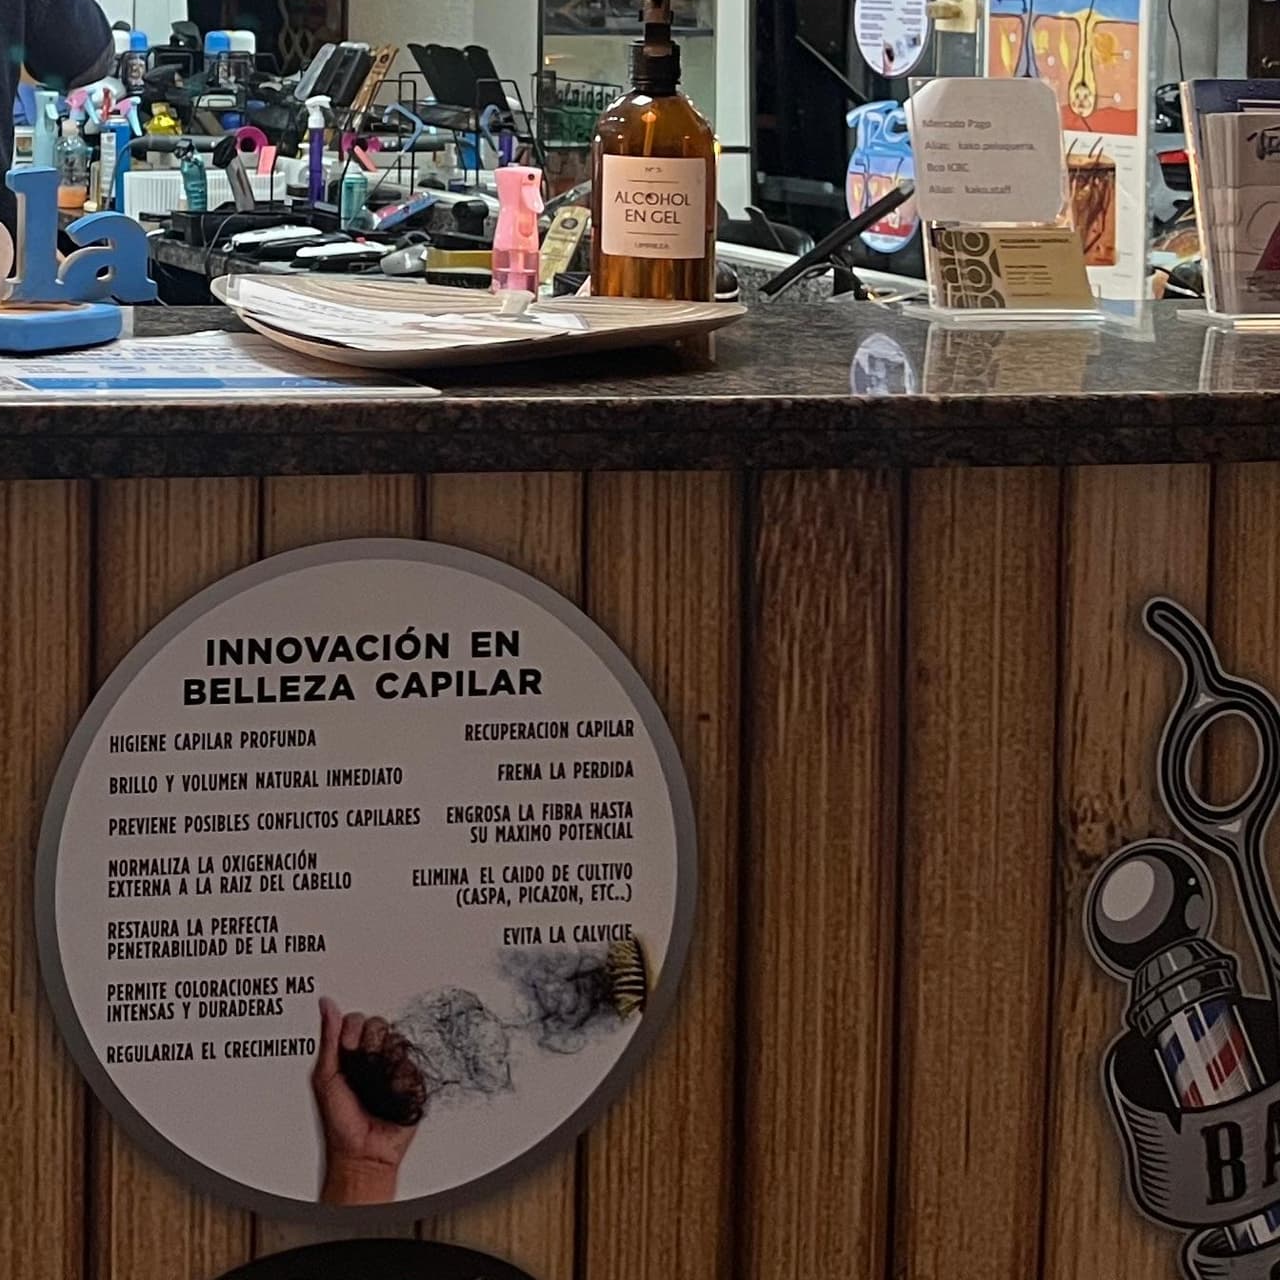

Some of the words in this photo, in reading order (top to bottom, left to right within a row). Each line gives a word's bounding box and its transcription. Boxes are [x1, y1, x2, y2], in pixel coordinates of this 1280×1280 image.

[614, 190, 691, 207] ALCOHOL
[625, 209, 646, 223] EN
[650, 210, 682, 225] GEL
[207, 626, 449, 666] INNOVACIÓN
[471, 630, 519, 658] EN
[184, 674, 355, 705] BELLEZA
[376, 669, 542, 699] CAPILAR
[110, 734, 166, 753] HIGIENE
[174, 732, 232, 751] CAPILAR
[240, 729, 316, 749] PROFUNDA
[465, 721, 569, 741] RECUPERACION
[577, 720, 634, 738] CAPILAR
[110, 776, 157, 795] BRILLO
[165, 775, 174, 792] Y
[182, 772, 248, 792] VOLUMEN
[256, 770, 319, 789] NATURAL
[326, 767, 402, 787] INMEDIATO
[498, 763, 542, 781] FRENA
[550, 762, 566, 780] LA
[573, 760, 634, 779] PERDIDA
[109, 816, 176, 836] PREVIENE
[185, 814, 250, 833] POSIBLES
[257, 810, 338, 830] CONFLICTOS
[346, 808, 420, 827] CAPILARES
[447, 805, 511, 824] ENGROSA
[519, 804, 535, 821] LA
[542, 803, 583, 821] FIBRA
[590, 801, 633, 819] HASTA
[470, 826, 487, 843] SU
[496, 824, 551, 843] MAXIMO
[559, 822, 634, 841] POTENCIAL
[109, 856, 190, 877] NORMALIZA
[198, 856, 214, 874] LA
[222, 849, 317, 873] OXIGENACIÓN
[413, 867, 469, 887] ELIMINA
[480, 866, 495, 884] EL
[503, 865, 544, 883] CAIDO
[552, 865, 569, 882] DE
[577, 862, 632, 881] CULTIVO
[108, 878, 171, 898] EXTERNA
[179, 877, 188, 895] A
[196, 877, 212, 895] LA
[220, 875, 252, 894] RAIZ
[260, 874, 285, 892] DEL
[293, 872, 351, 891] CABELLO
[456, 887, 511, 908] (CASPA,
[519, 885, 583, 905] PICAZON,
[591, 883, 632, 902] ETC..)
[108, 919, 179, 940] RESTAURA
[187, 918, 203, 936] LA
[211, 915, 278, 936] PERFECTA
[504, 926, 542, 945] EVITA
[550, 926, 566, 943] LA
[573, 923, 633, 943] CALVICIE
[108, 938, 227, 960] PENETRABILIDAD
[236, 937, 253, 955] DE
[261, 936, 277, 954] LA
[285, 934, 326, 953] FIBRA
[107, 982, 167, 1002] PERMITE
[175, 977, 278, 999] COLORACIONES
[286, 976, 314, 994] MAS
[107, 1002, 174, 1023] INTENSAS
[182, 1001, 191, 1019] Y
[199, 998, 283, 1018] DURADERAS
[107, 1042, 193, 1064] REGULARIZA
[202, 1042, 216, 1060] EL
[225, 1038, 315, 1058] CRECIMIENTO
